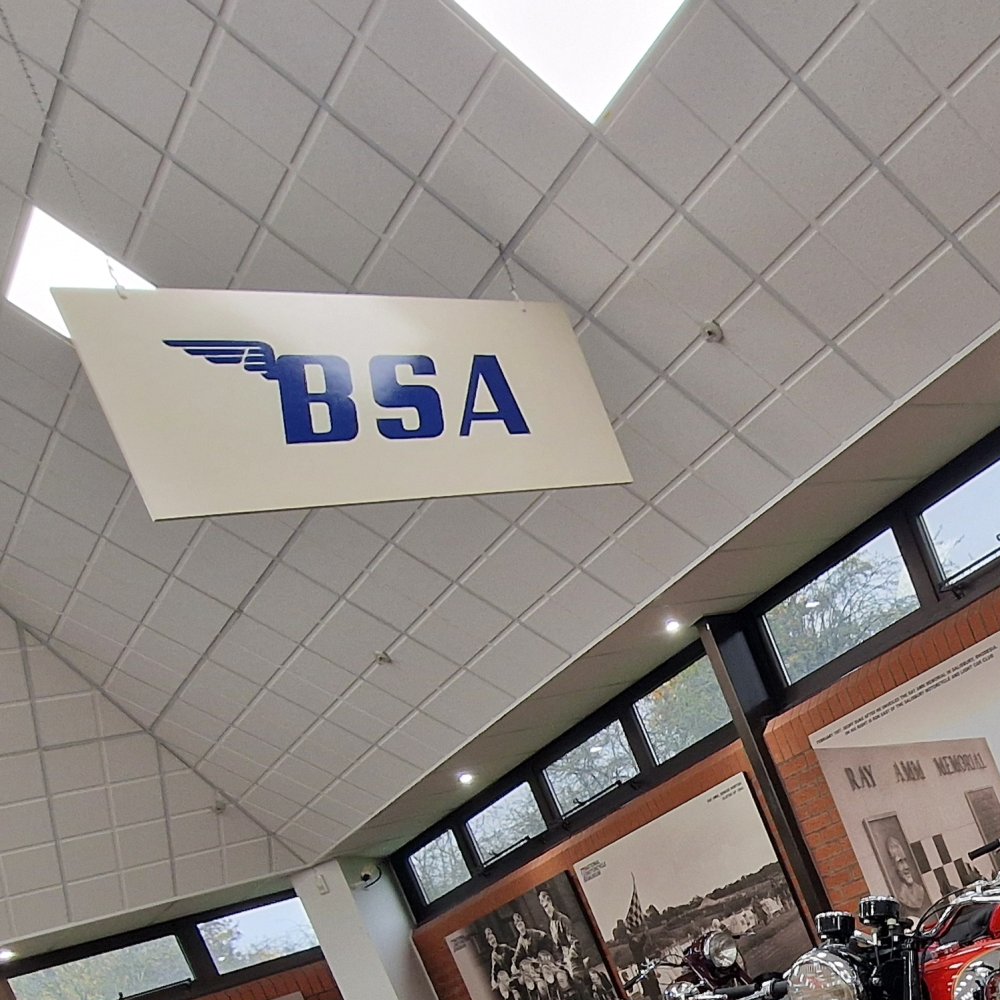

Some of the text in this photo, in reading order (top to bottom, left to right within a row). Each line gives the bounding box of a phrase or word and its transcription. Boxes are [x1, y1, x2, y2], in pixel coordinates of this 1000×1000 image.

[277, 354, 531, 444] BSA
[925, 676, 951, 693] MOTORCYCLE
[951, 672, 960, 680] AND
[960, 664, 973, 675] LIGHT
[973, 659, 982, 668] CAR
[926, 673, 946, 686] MEMORIAL
[844, 752, 987, 791] RAY AMM MEMORIAL
